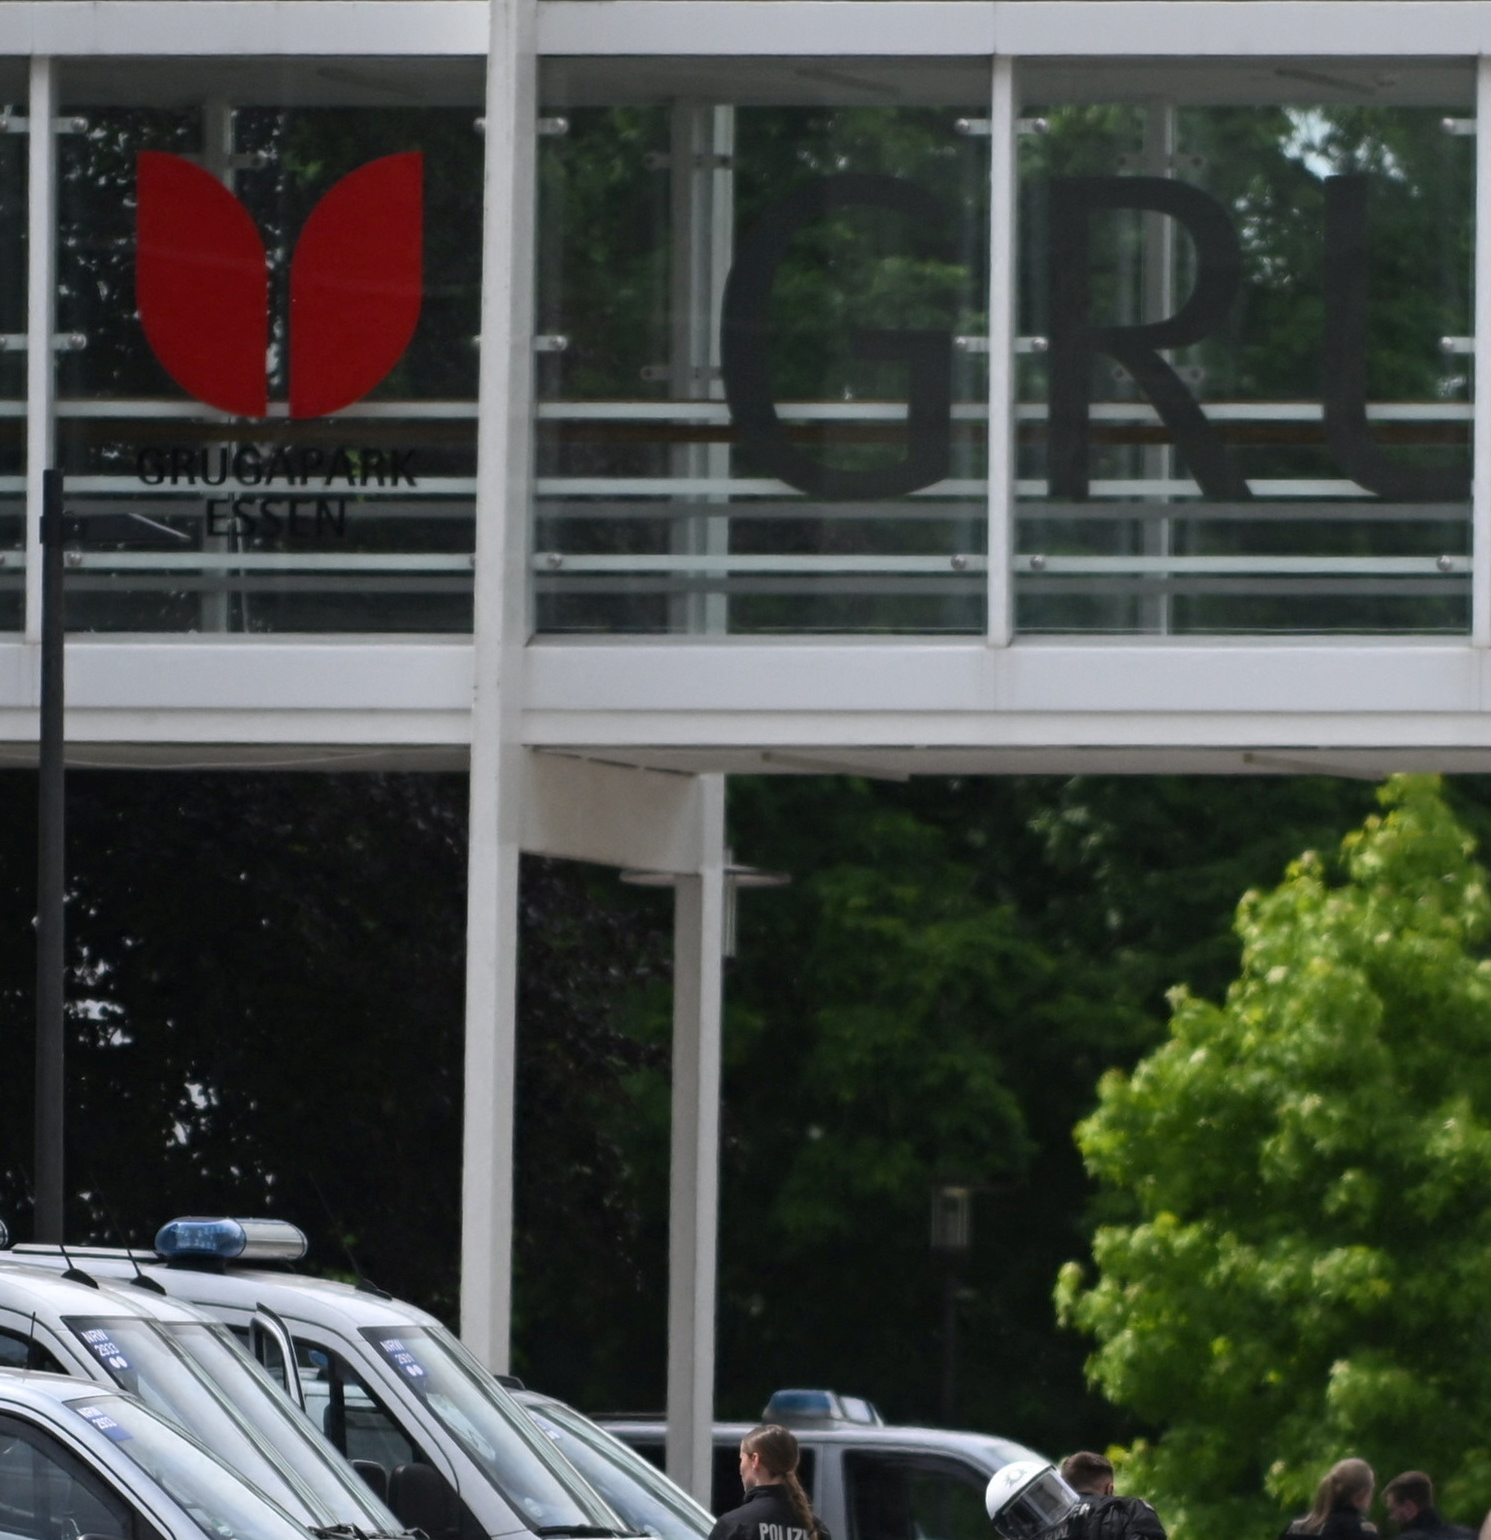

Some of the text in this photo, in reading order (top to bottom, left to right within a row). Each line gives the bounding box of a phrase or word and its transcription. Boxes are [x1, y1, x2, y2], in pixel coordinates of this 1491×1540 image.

[135, 446, 418, 488] GRUGAPARK
[205, 499, 347, 538] ESSEN
[81, 1329, 109, 1344] NRW
[380, 1339, 405, 1353] NRW
